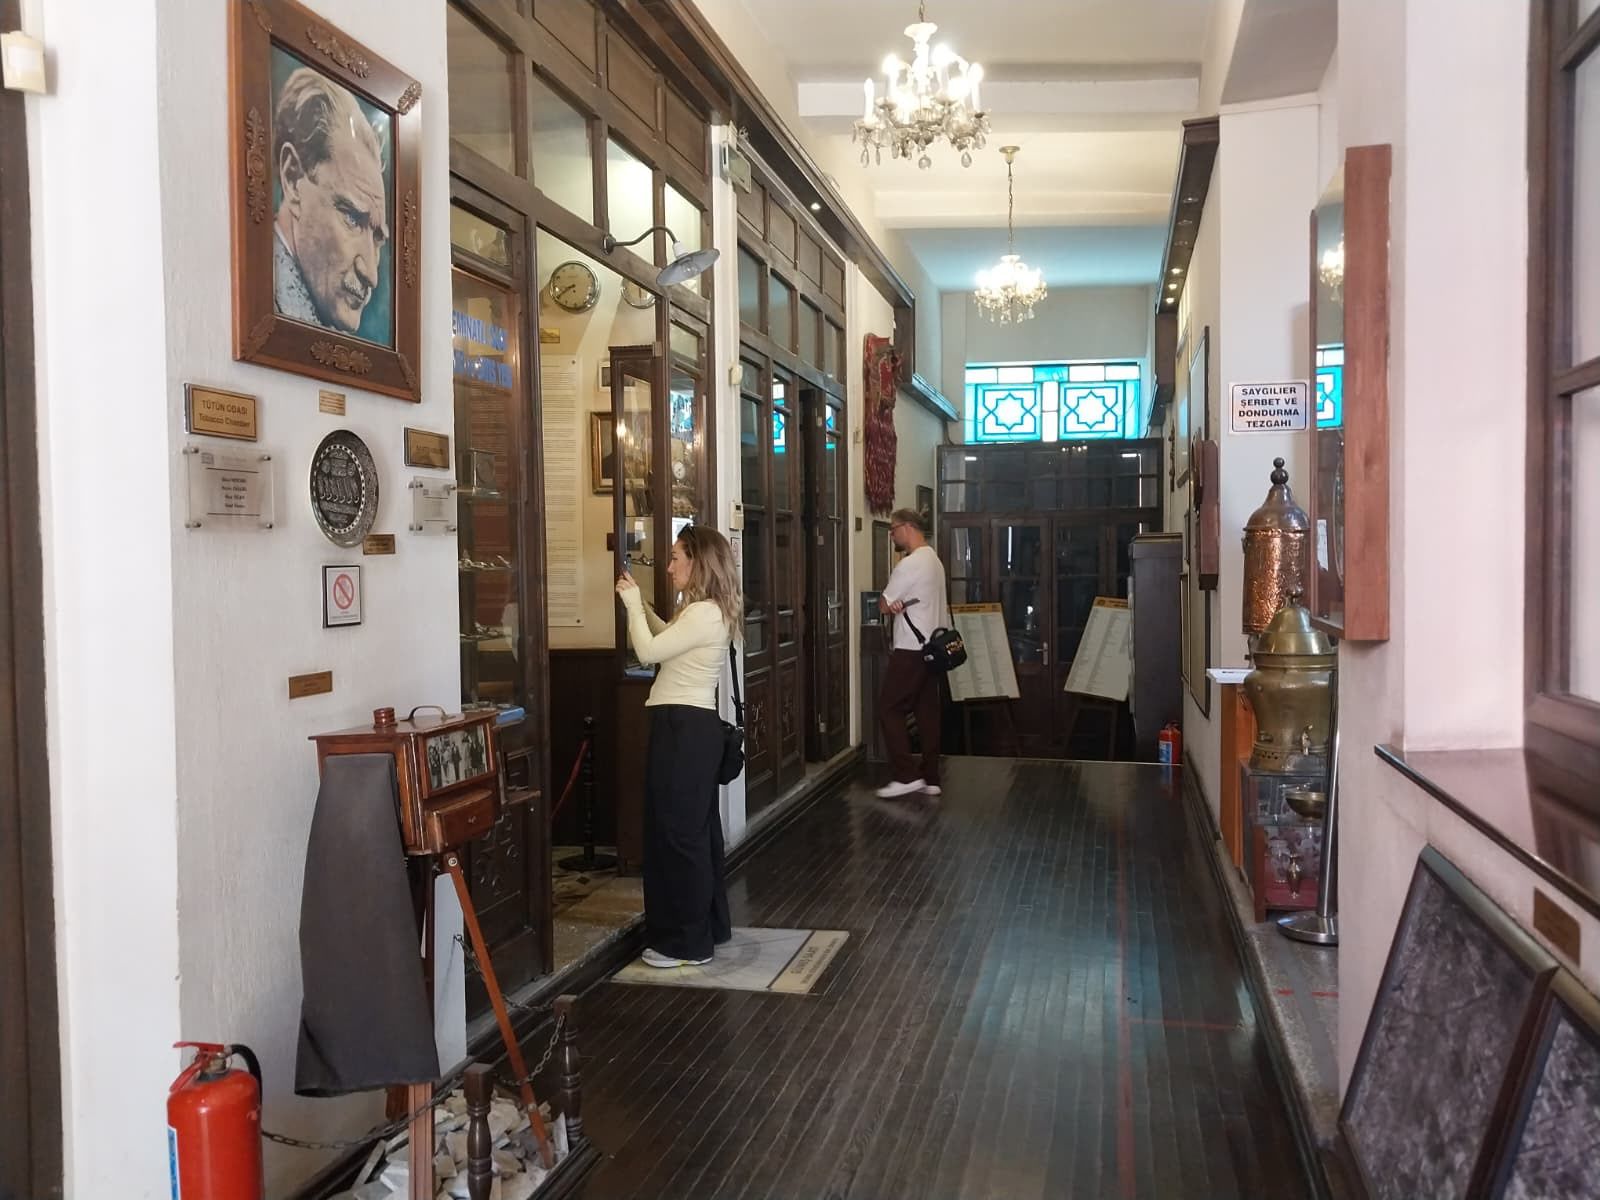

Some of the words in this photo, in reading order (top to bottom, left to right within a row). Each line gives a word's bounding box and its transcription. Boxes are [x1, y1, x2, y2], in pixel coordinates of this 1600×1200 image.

[1240, 398, 1280, 408] ŞERBET
[1284, 397, 1297, 405] VE
[1238, 408, 1299, 417] DONDURMA
[1246, 420, 1291, 428] TEZGAHI
